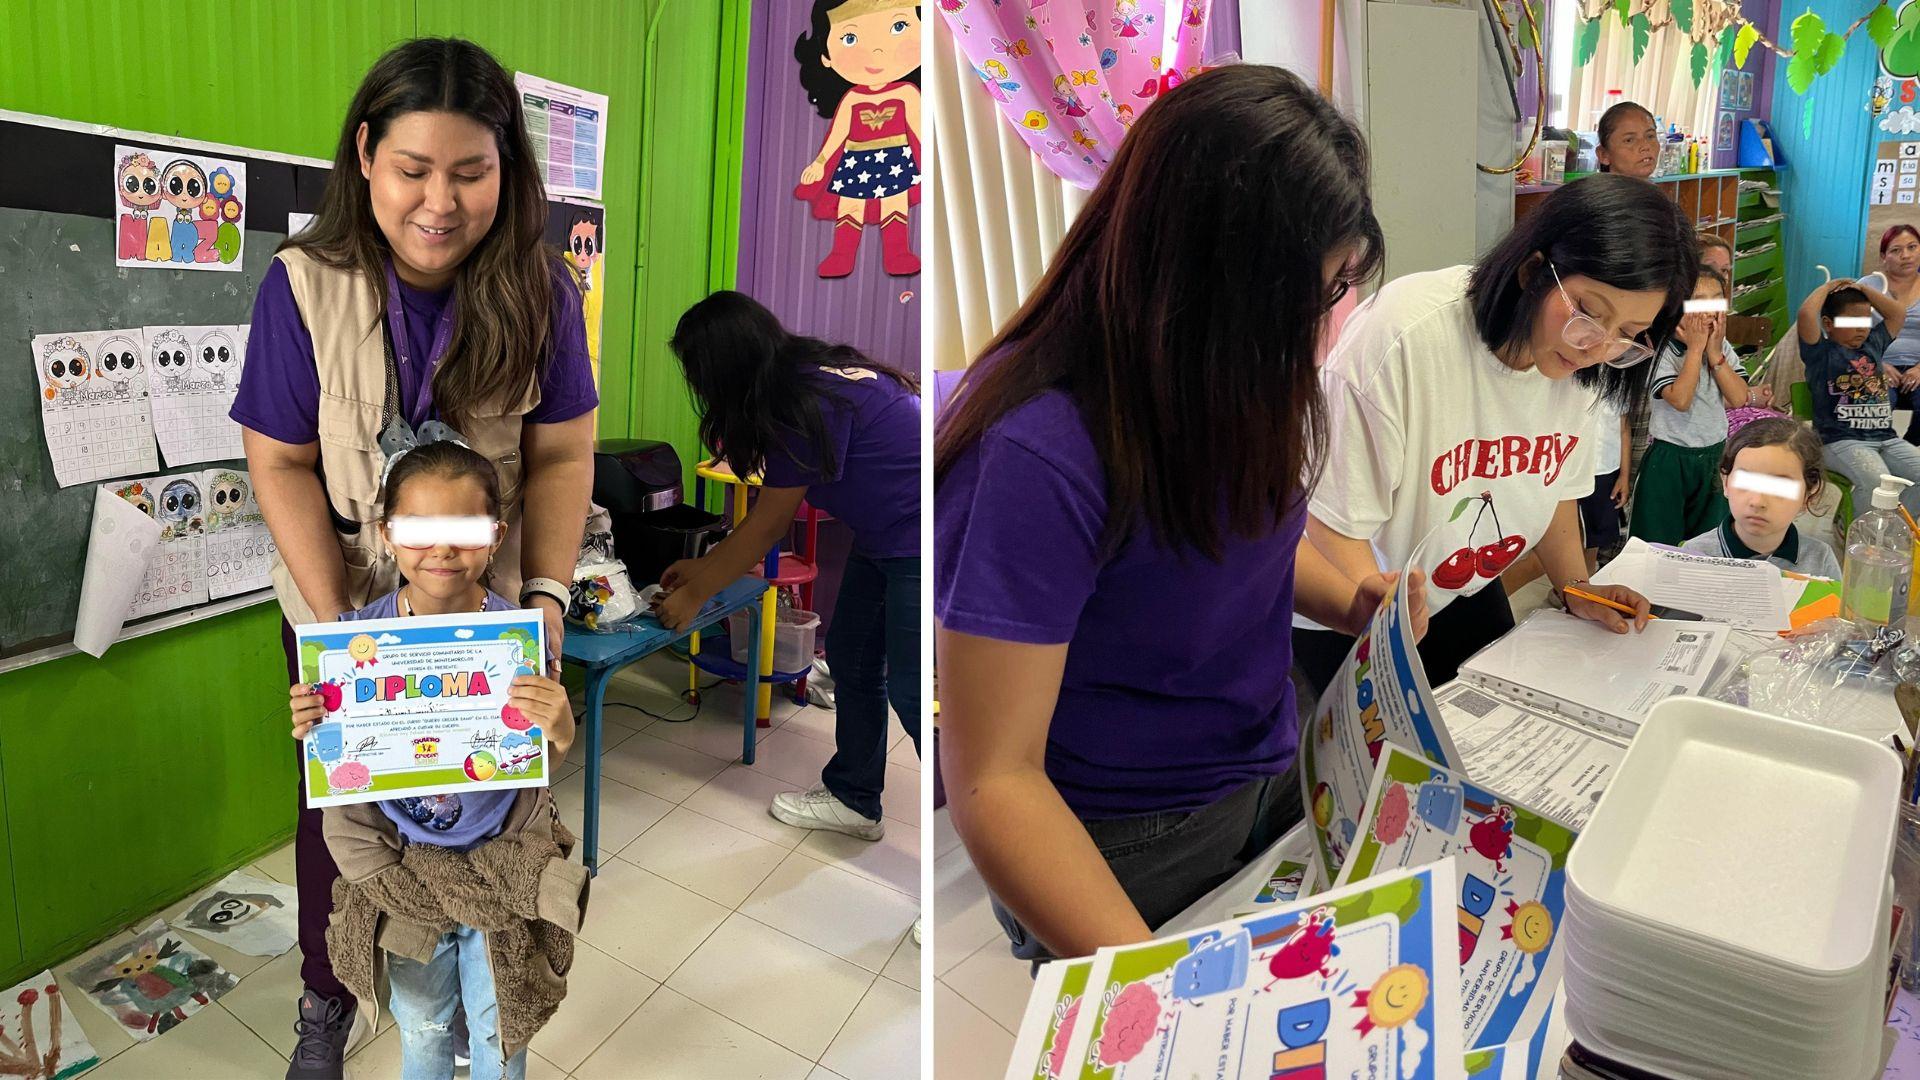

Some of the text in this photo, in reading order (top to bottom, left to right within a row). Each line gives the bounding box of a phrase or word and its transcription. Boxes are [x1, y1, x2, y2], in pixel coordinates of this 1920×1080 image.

[1905, 145, 1917, 156] a
[1878, 162, 1894, 173] m
[119, 213, 241, 264] MARZO
[80, 390, 113, 400] Marzo
[181, 380, 212, 390] Marzo
[1849, 418, 1890, 429] THINGS
[1431, 432, 1579, 496] CHERRY
[355, 671, 491, 703] DIPLOMA
[1462, 959, 1492, 1012] UNIVERSIDAD
[1464, 950, 1508, 1030] GRUPO DE SERVICIO
[1220, 1018, 1233, 1051] HABER
